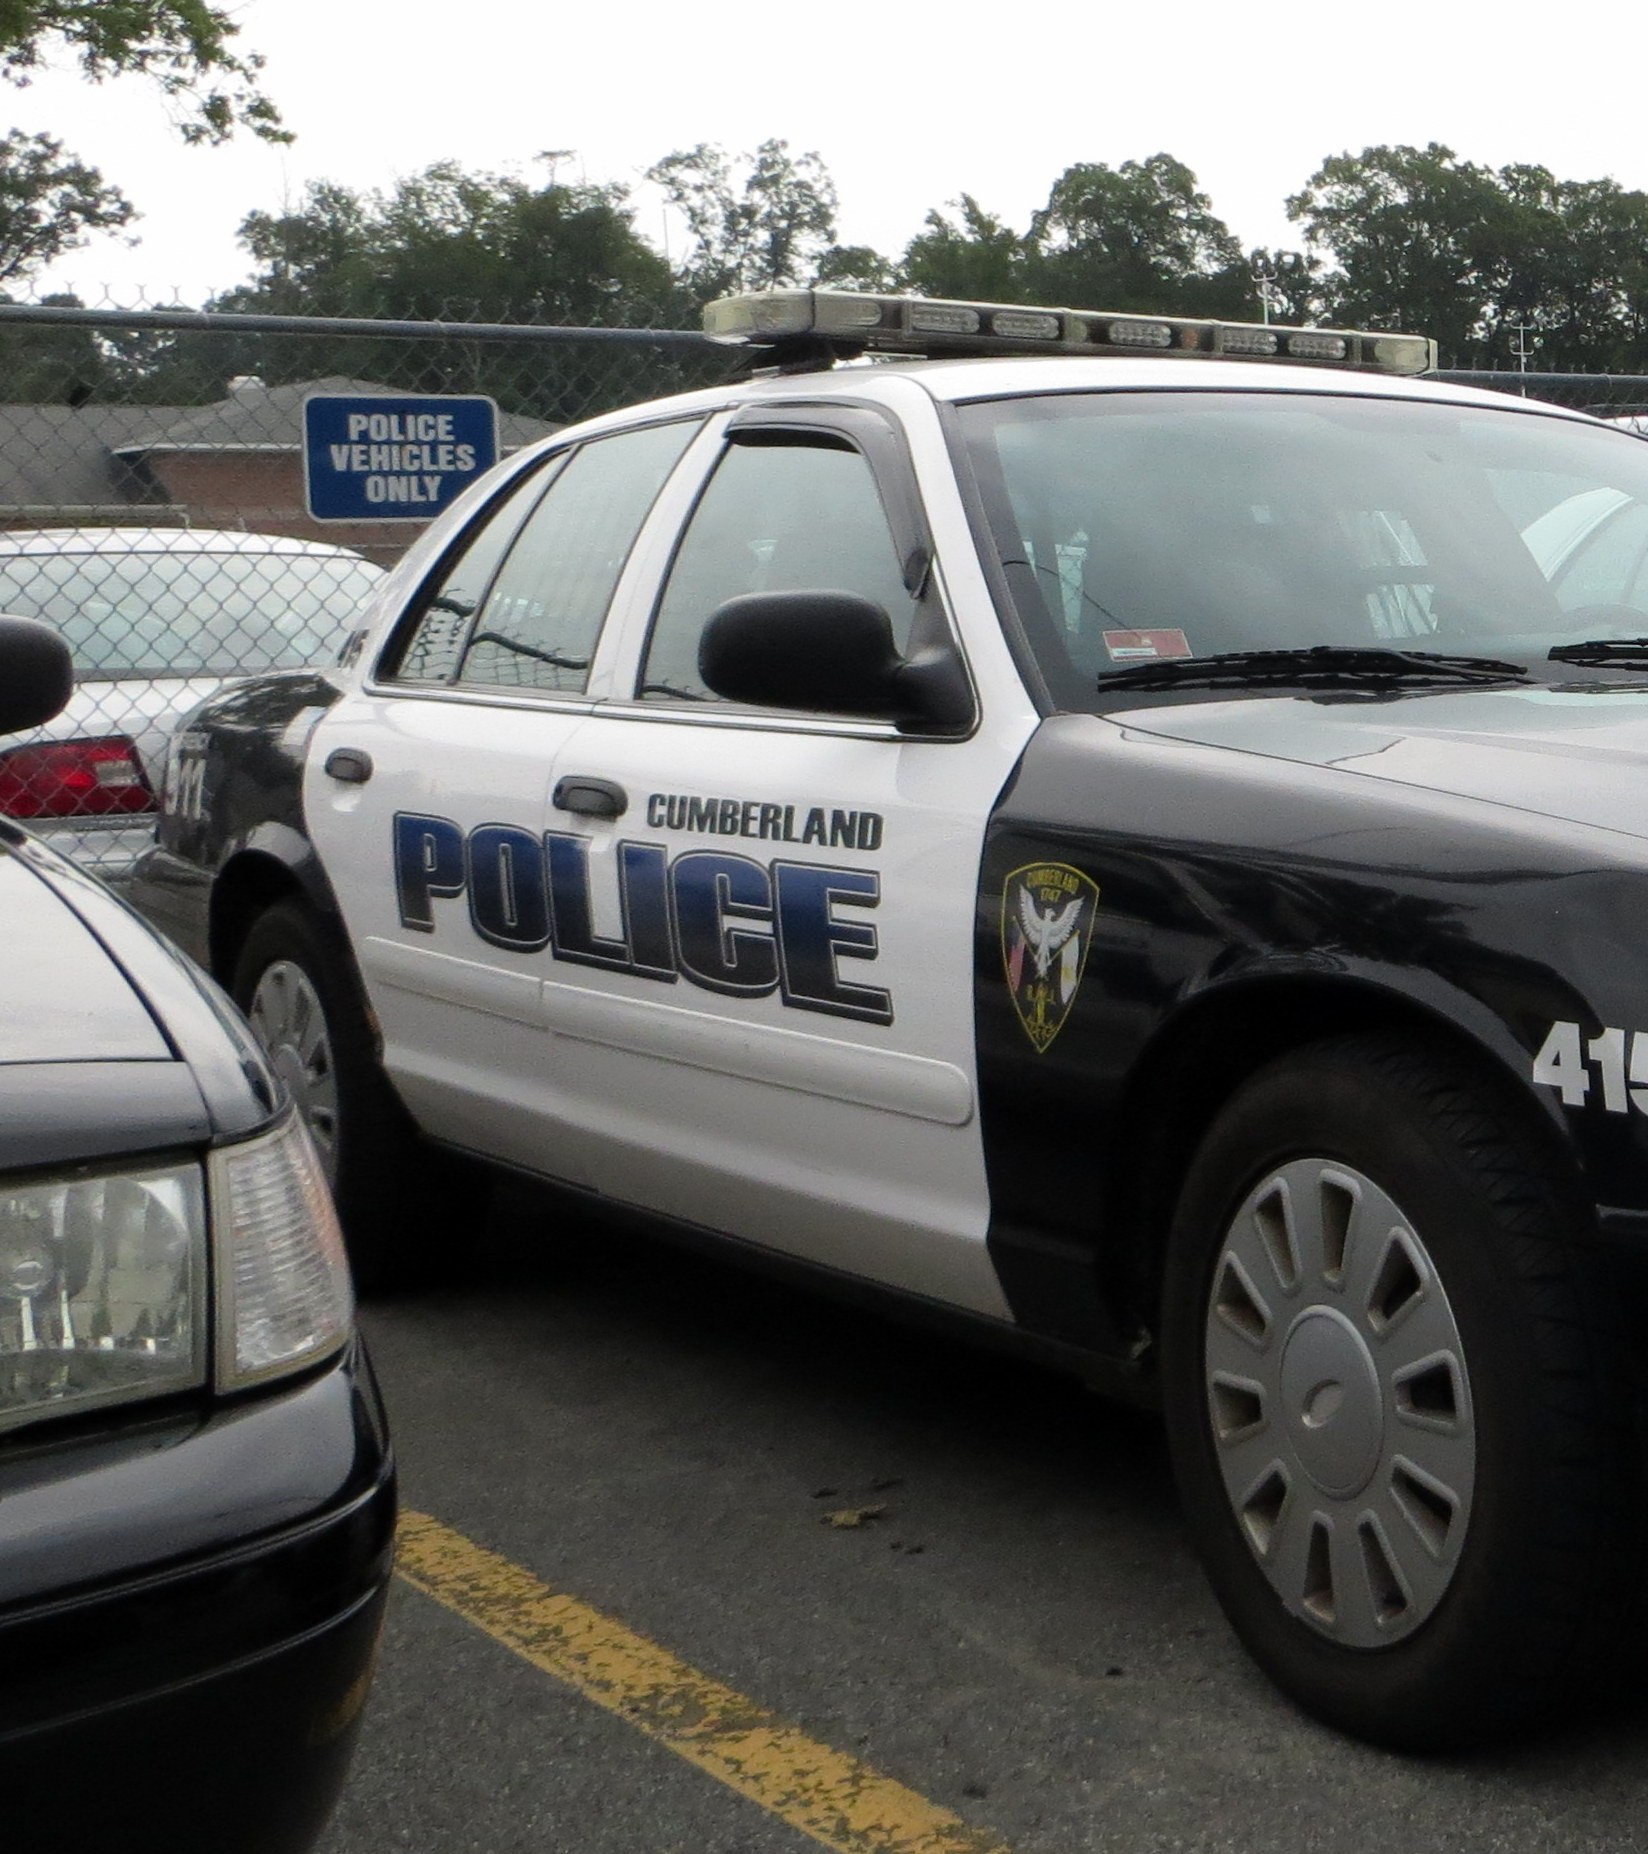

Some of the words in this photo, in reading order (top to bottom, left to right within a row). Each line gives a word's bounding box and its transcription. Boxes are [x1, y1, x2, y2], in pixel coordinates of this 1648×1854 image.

[347, 414, 455, 441] POLICE
[330, 444, 475, 472] VEHICLES
[366, 475, 442, 502] ONLY
[647, 792, 885, 851] CUMBERLAND
[392, 810, 895, 1028] POLICE
